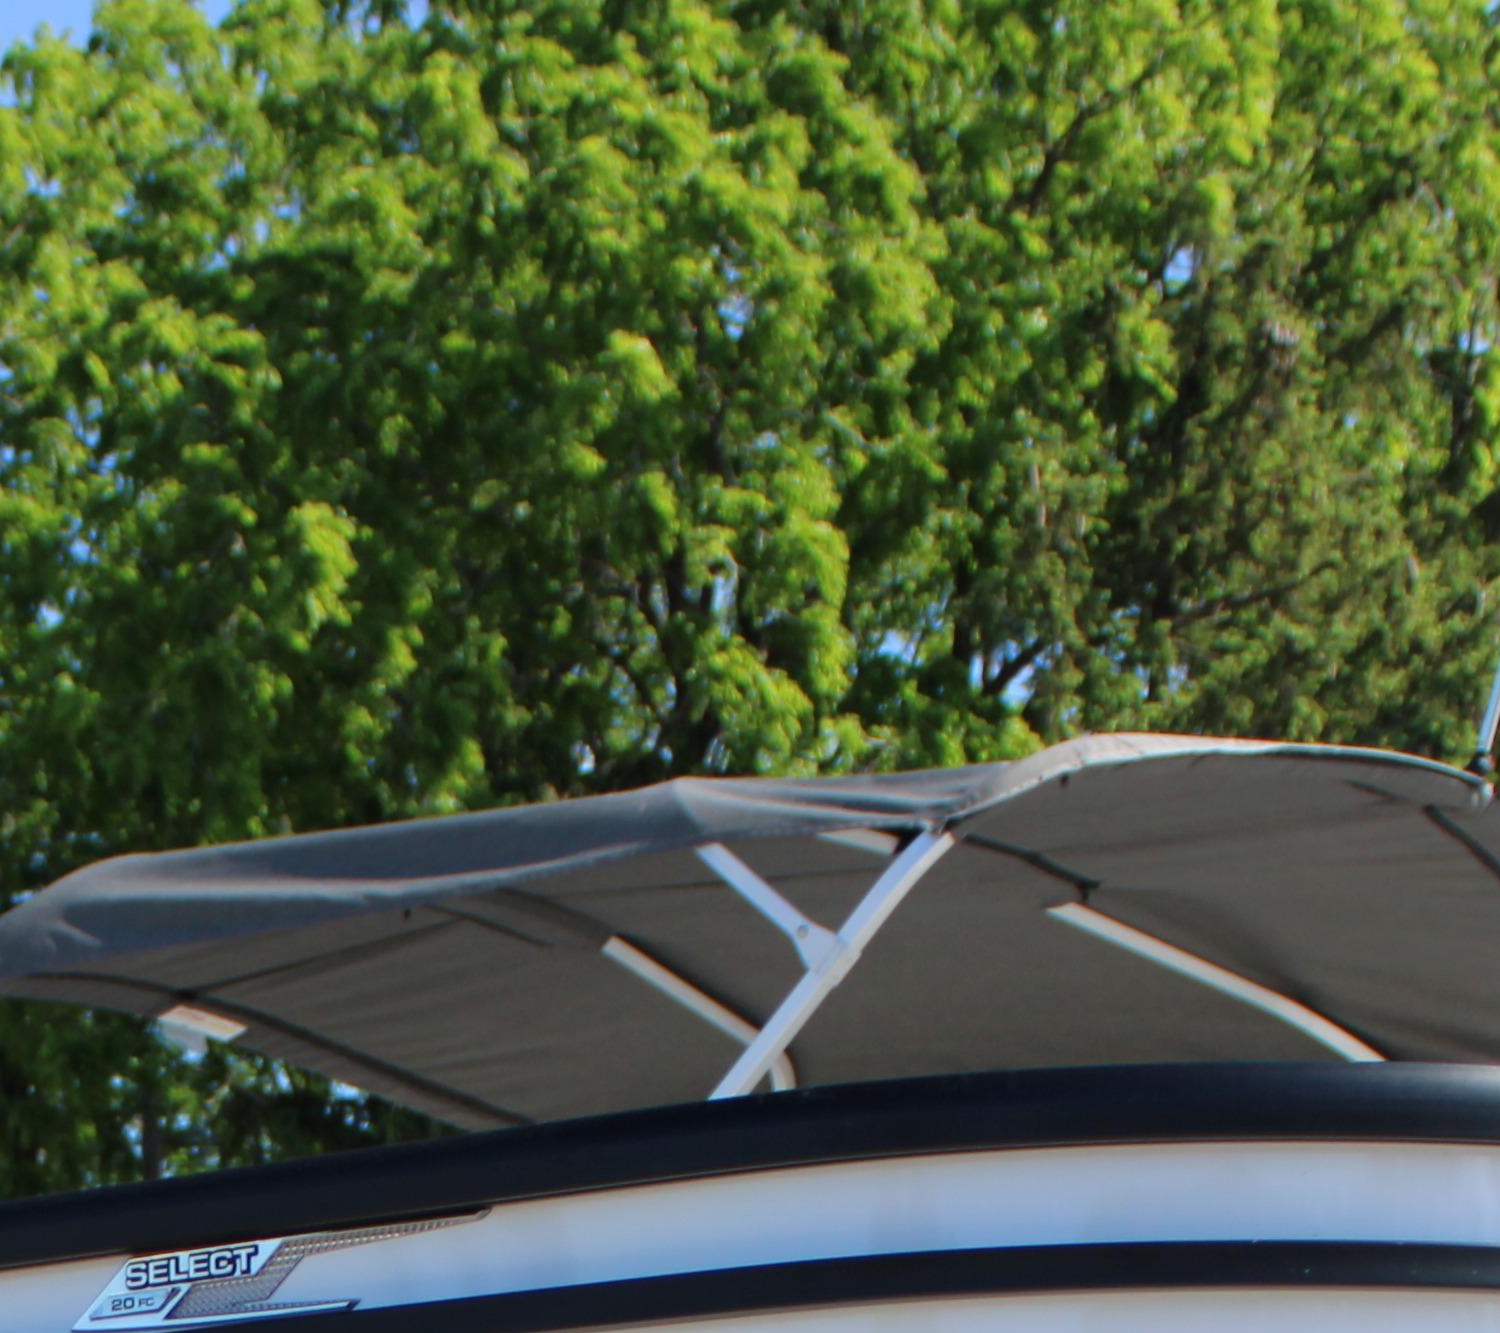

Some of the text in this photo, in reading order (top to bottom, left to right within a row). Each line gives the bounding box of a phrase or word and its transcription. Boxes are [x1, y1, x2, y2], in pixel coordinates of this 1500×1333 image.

[125, 1244, 258, 1290] SELECT
[111, 1297, 154, 1311] 20 FC
